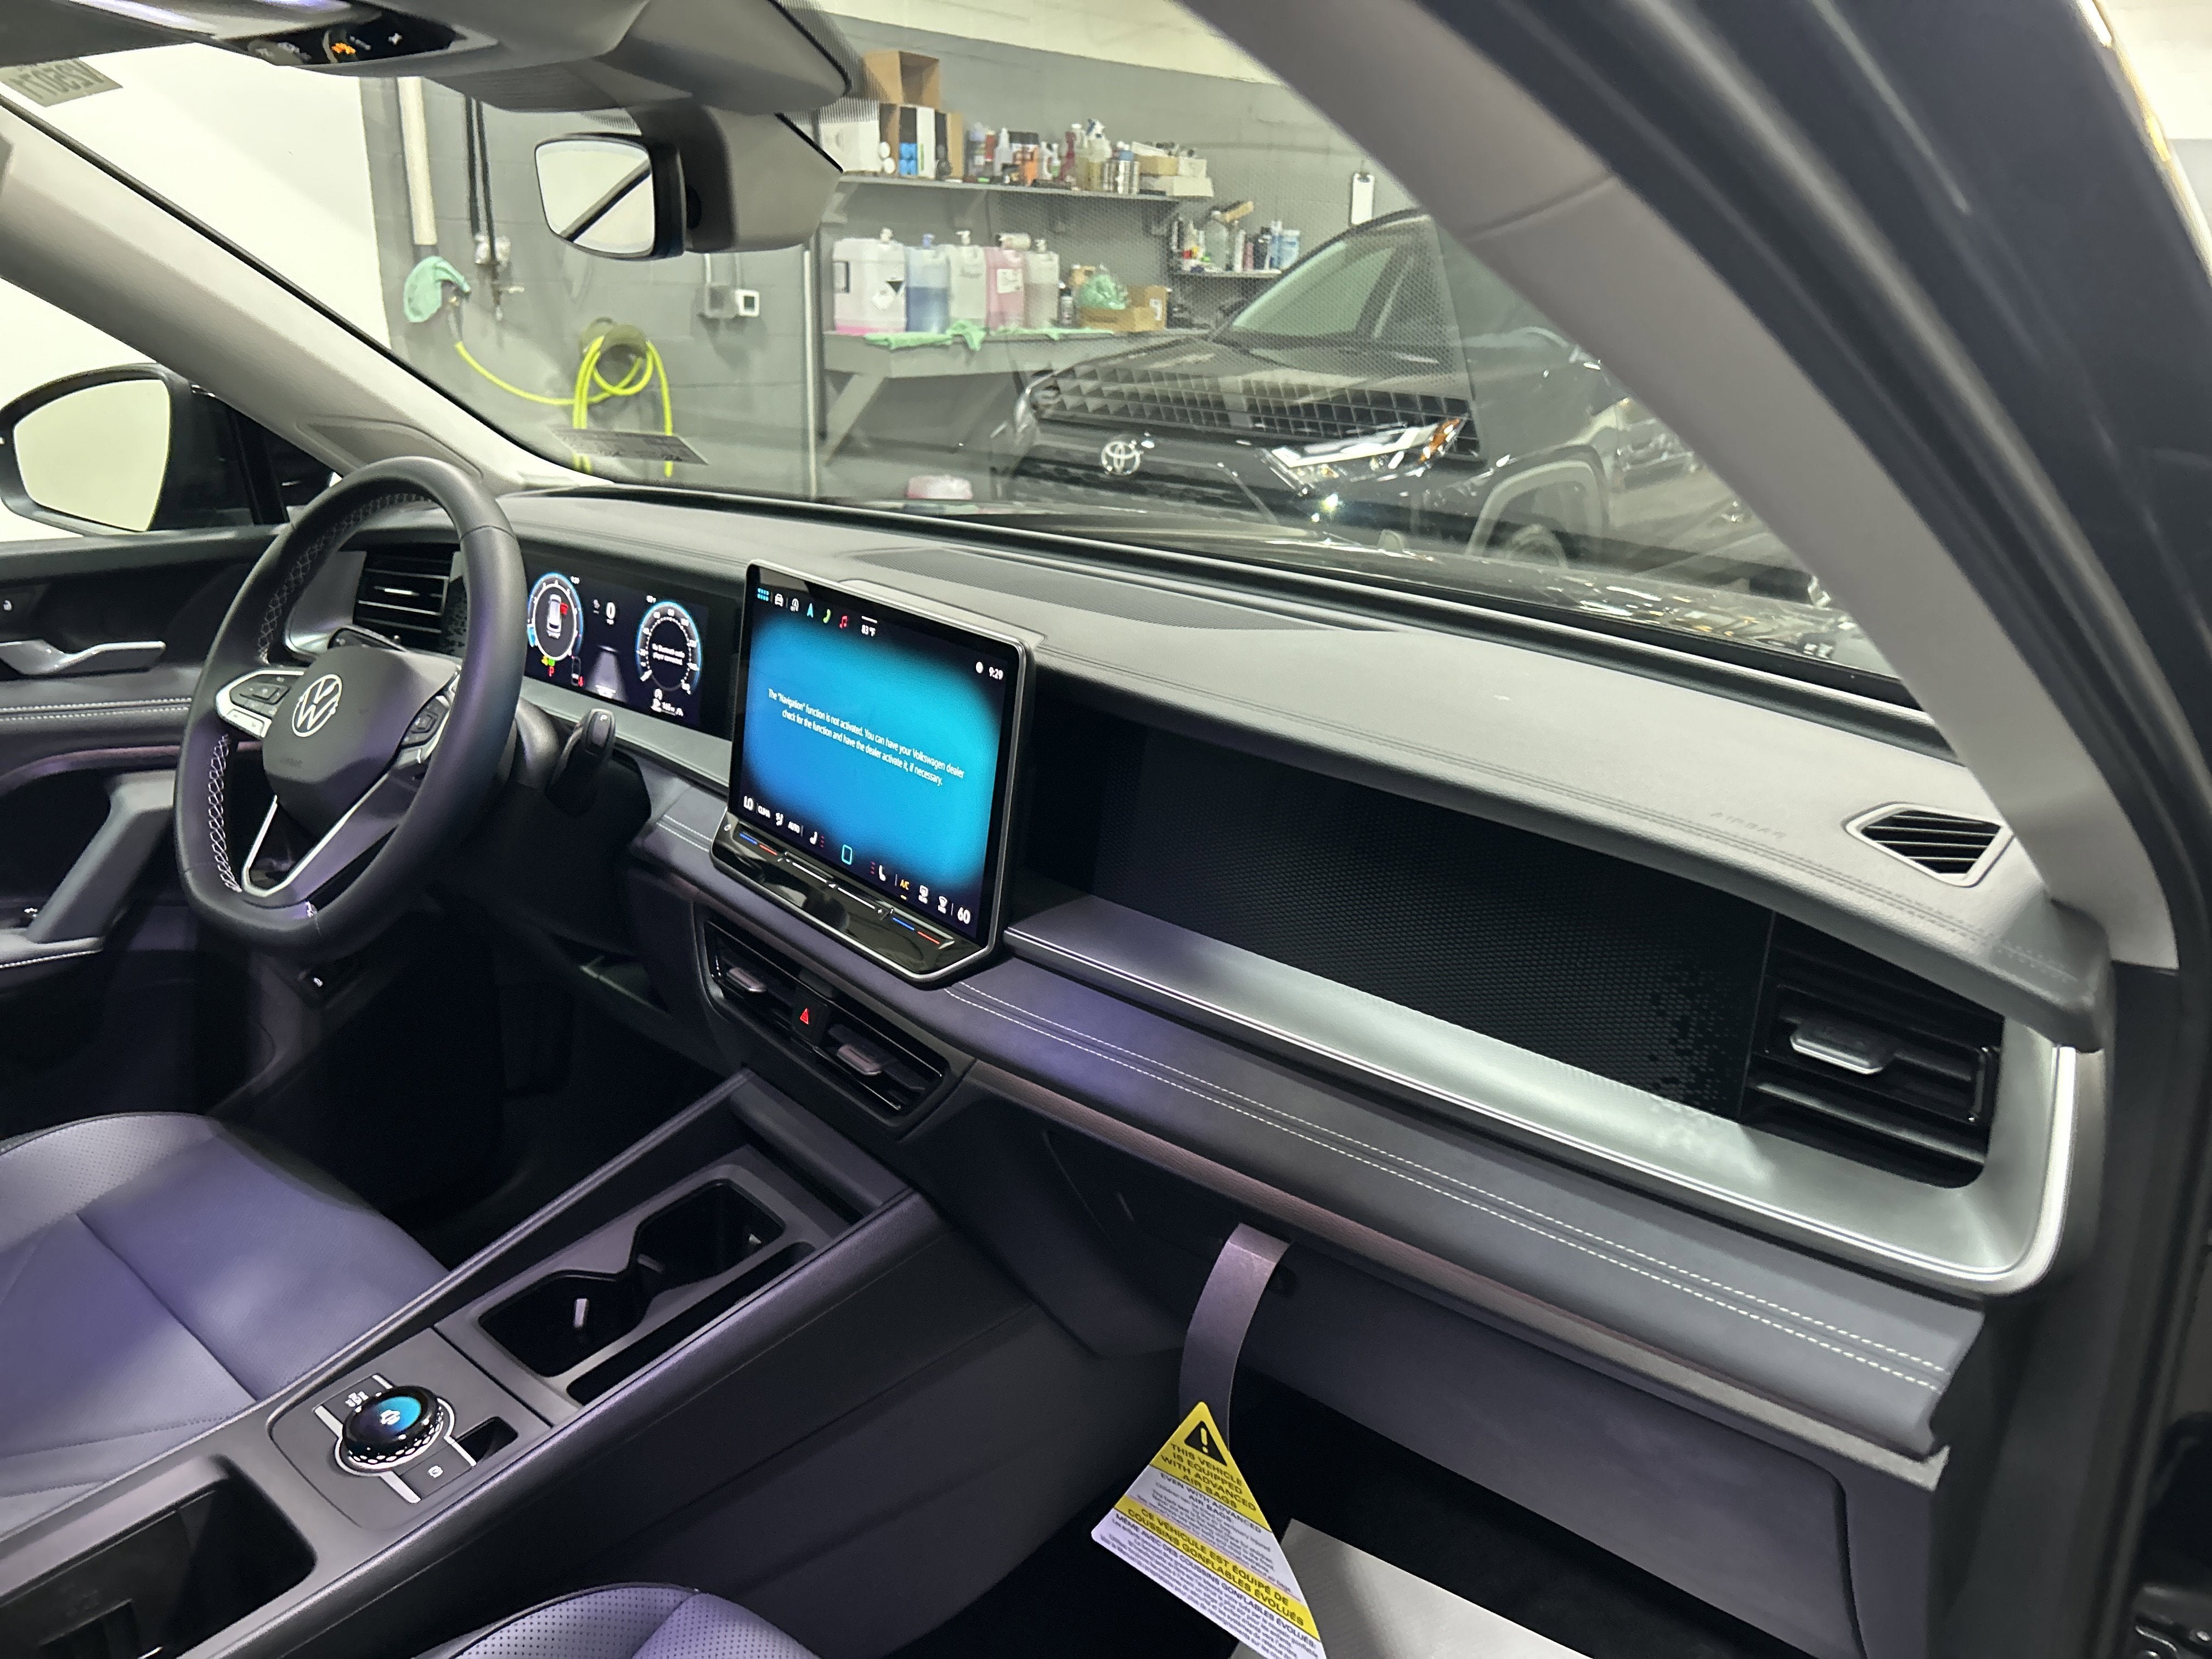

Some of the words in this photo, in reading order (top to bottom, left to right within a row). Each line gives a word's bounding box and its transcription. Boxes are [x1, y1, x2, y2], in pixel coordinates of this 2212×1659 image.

[989, 667, 1003, 680] 9:29
[769, 688, 777, 700] The
[805, 704, 825, 720] function
[826, 713, 831, 723] is
[831, 716, 840, 727] not
[865, 728, 874, 741] You
[874, 735, 885, 745] can
[885, 737, 899, 751] have
[898, 745, 912, 757] your
[912, 748, 946, 770] Volkswagen
[946, 763, 964, 778] dealer
[782, 709, 796, 722] check
[804, 718, 812, 729] the
[812, 720, 832, 737] function
[832, 731, 843, 742] and
[843, 733, 856, 748] have
[856, 740, 865, 752] the
[865, 744, 882, 759] dealer
[882, 753, 903, 768] activate
[909, 762, 915, 772] if
[743, 795, 754, 811] LO
[788, 821, 800, 833] AUTO
[900, 879, 910, 890] A/C
[957, 907, 971, 924] 60
[1161, 1454, 1191, 1475] WITH
[1194, 1472, 1256, 1511] ADVANCED
[1171, 1443, 1195, 1460] THIS
[1198, 1456, 1243, 1487] VEHICLE
[1187, 1459, 1243, 1494] EQUIPPED
[1205, 1486, 1237, 1509] BAGS
[1128, 1509, 1180, 1547] COUSSINS
[1182, 1543, 1251, 1592] GONFLABLES
[1141, 1508, 1154, 1521] CE
[1209, 1550, 1229, 1568] EST
[1274, 1592, 1289, 1606] DE
[1221, 1582, 1274, 1621] GONFLABLES
